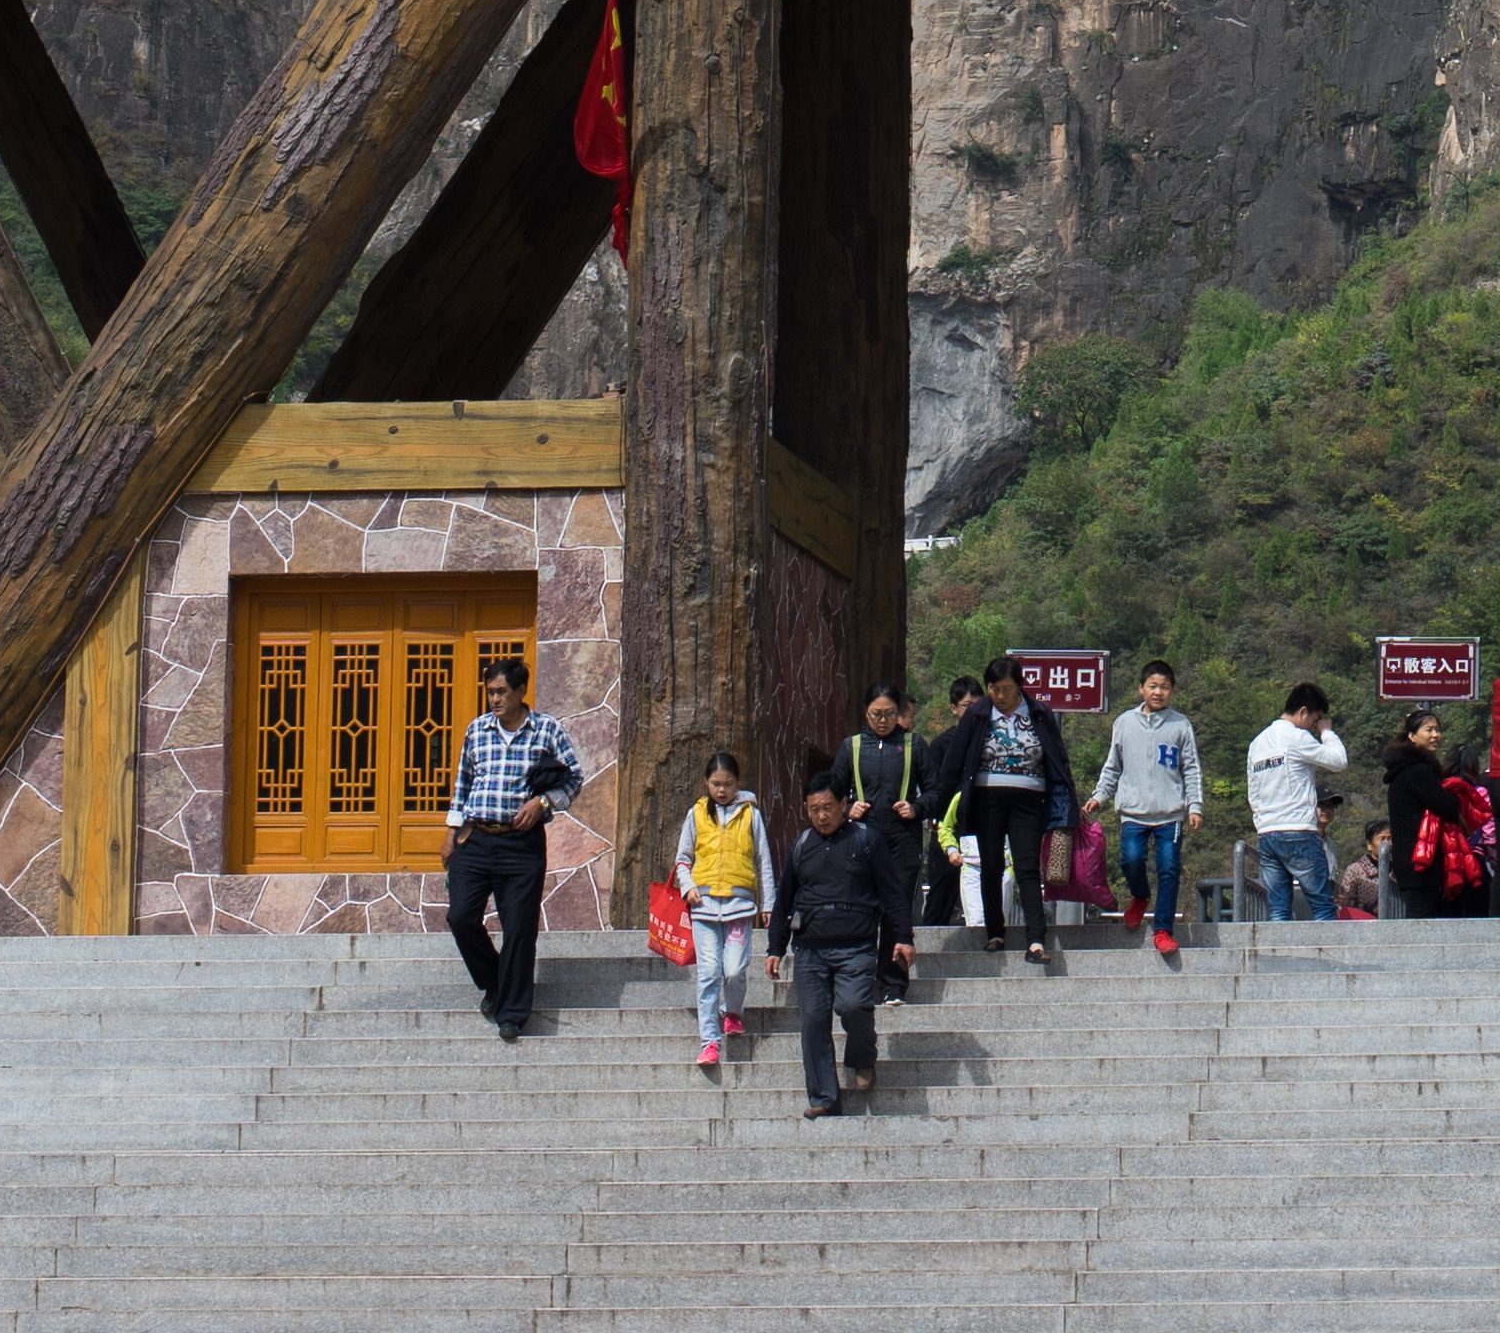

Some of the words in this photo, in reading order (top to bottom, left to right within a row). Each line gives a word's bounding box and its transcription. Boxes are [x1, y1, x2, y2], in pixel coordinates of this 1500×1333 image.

[1404, 657, 1469, 674] 散客入口
[1048, 666, 1095, 689] 出口
[1035, 693, 1052, 701] Exit
[1158, 743, 1179, 769] H
